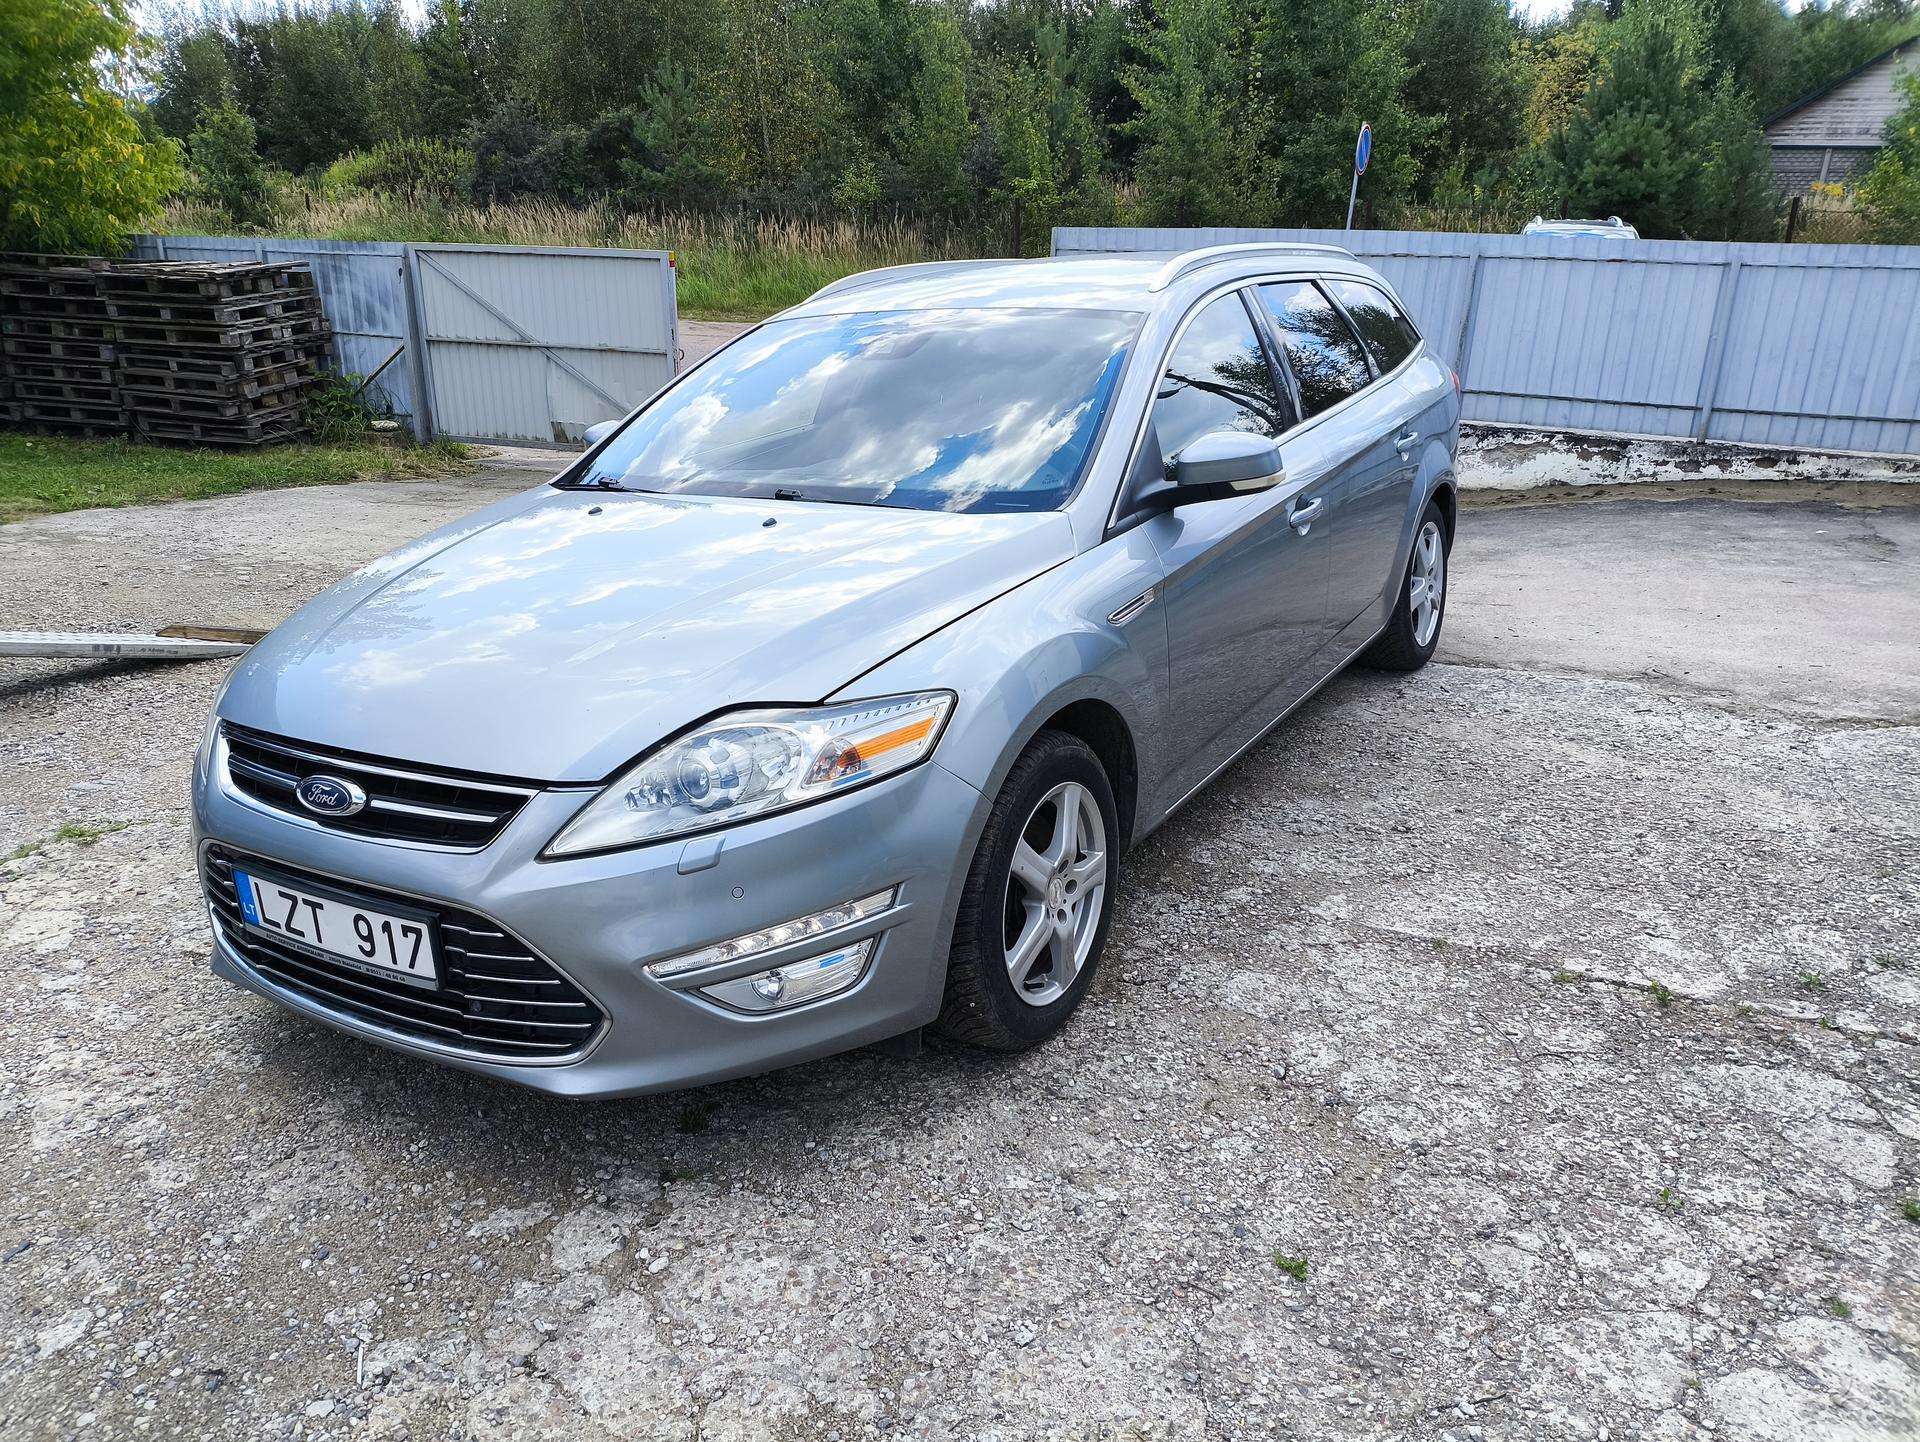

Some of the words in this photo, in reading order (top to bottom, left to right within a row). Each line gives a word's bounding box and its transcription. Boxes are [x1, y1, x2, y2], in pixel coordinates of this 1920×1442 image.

[308, 784, 338, 805] Ford
[243, 902, 255, 915] LT
[254, 882, 324, 943] LZT
[353, 913, 423, 969] 917
